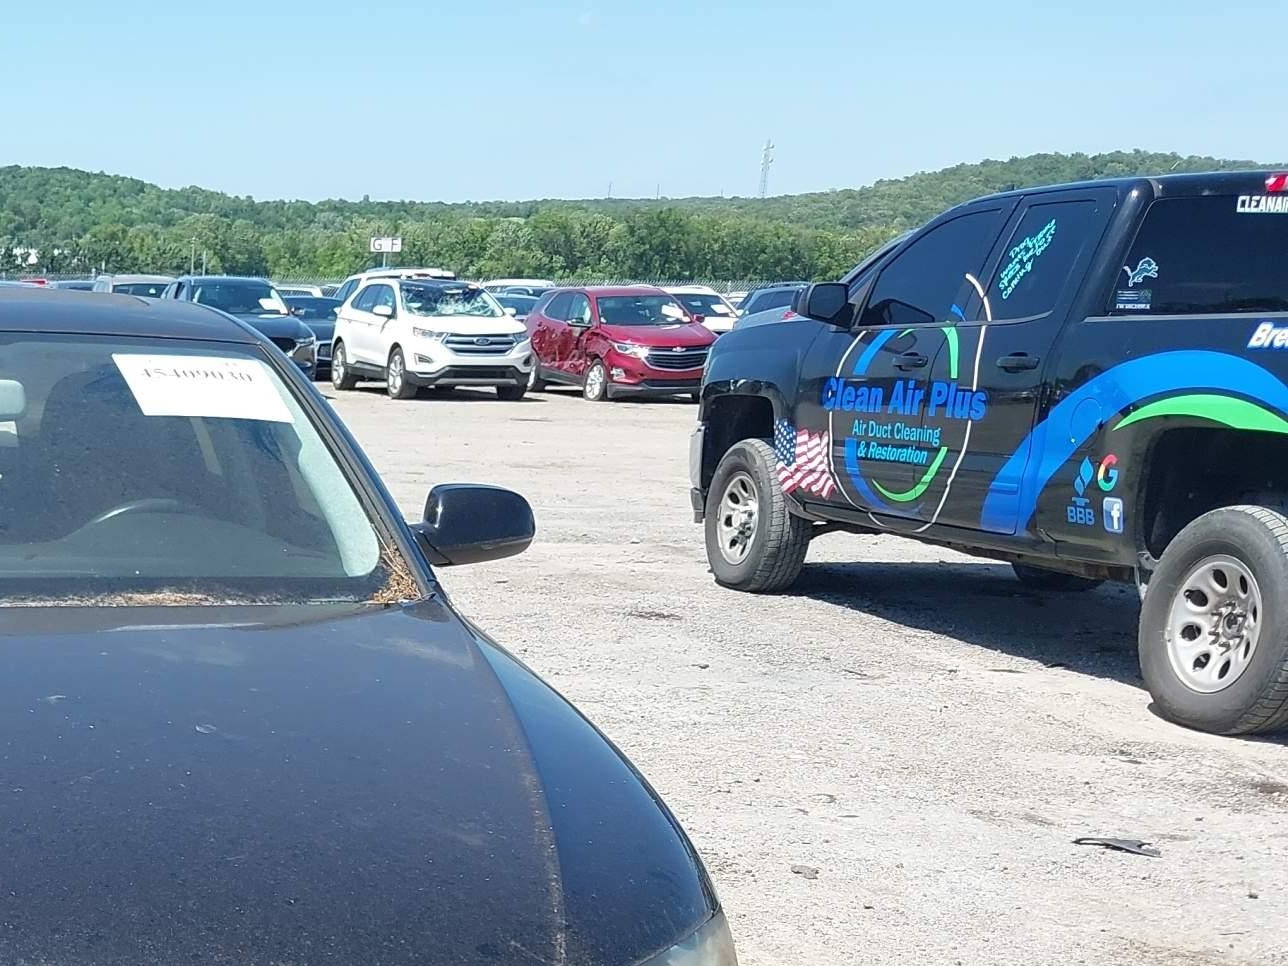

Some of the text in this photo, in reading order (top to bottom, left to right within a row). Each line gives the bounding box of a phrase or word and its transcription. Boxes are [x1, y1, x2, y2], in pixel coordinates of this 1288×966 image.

[373, 238, 383, 251] G
[1246, 321, 1288, 349] Bre
[822, 376, 988, 421] Clean Air Plus
[852, 419, 942, 447] Air Duct Cleaning
[857, 440, 928, 465] & Restoration
[1067, 506, 1095, 526] BBB
